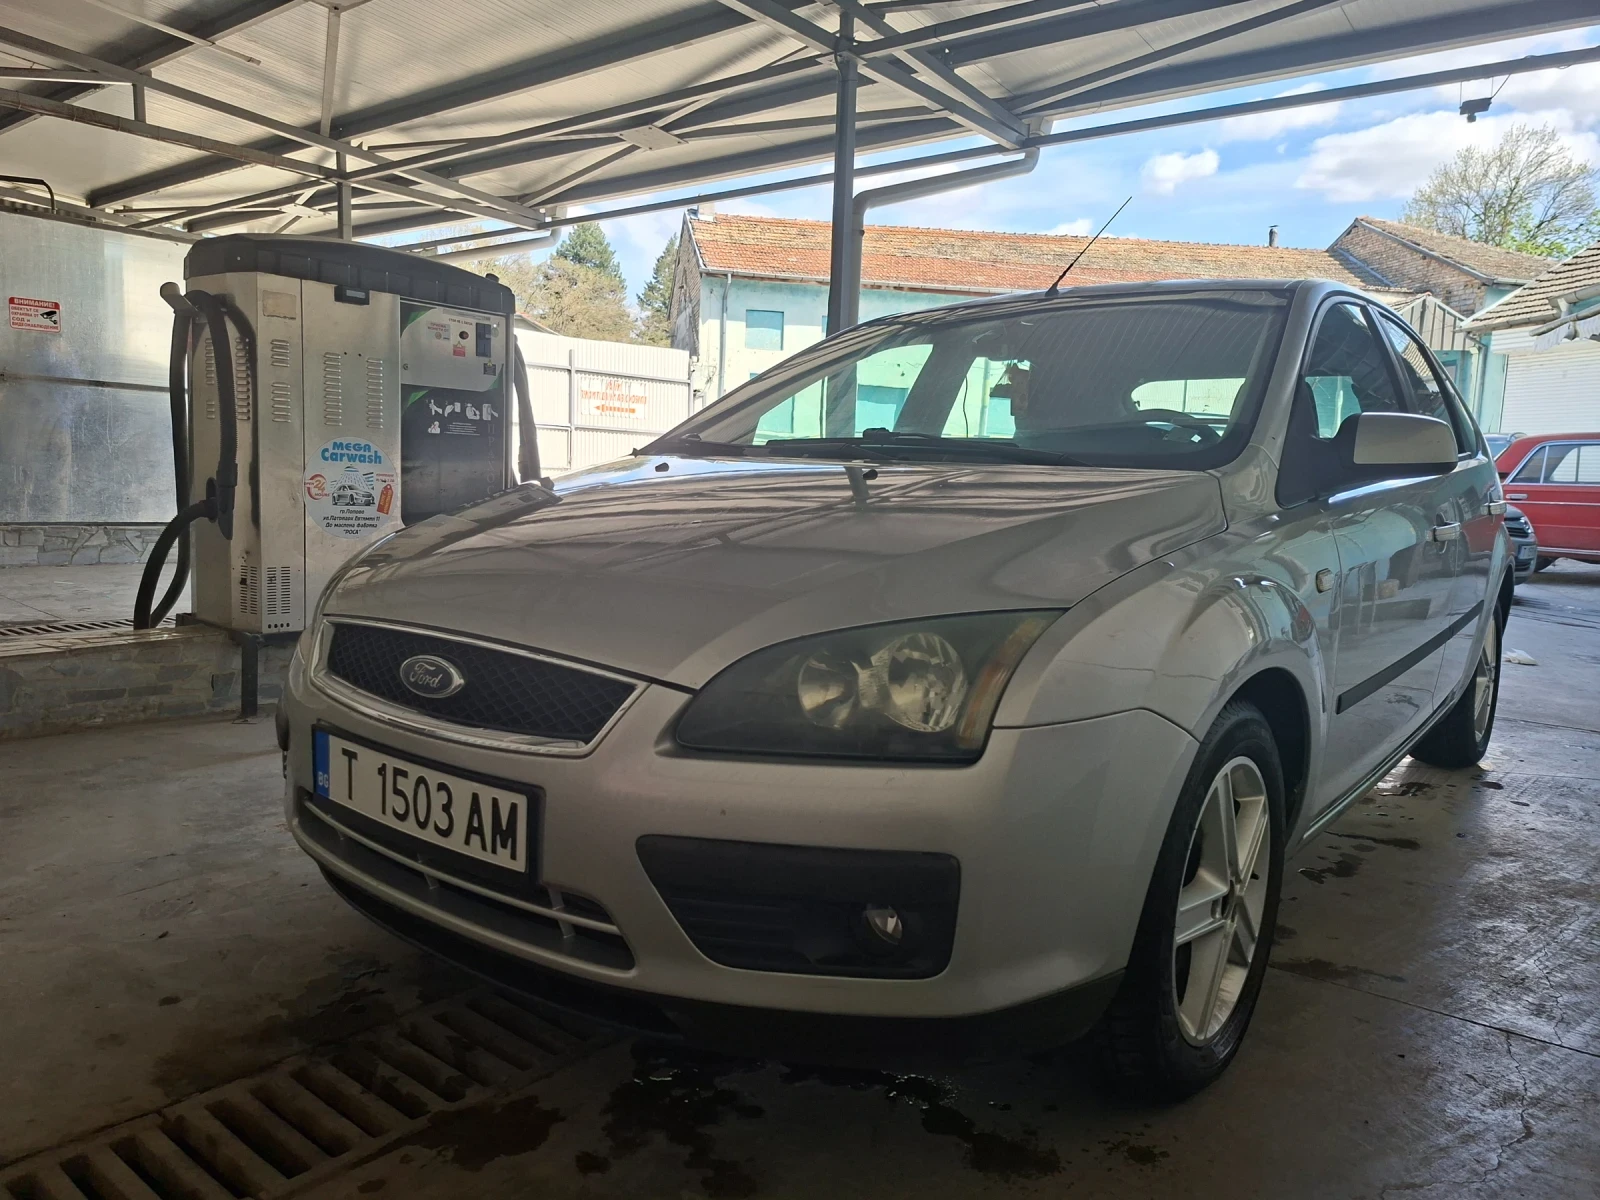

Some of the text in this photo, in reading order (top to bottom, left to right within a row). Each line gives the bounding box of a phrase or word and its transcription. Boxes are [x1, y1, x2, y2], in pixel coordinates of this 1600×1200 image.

[14, 298, 56, 308] ВНИМАНИЕ!
[332, 441, 371, 452] MEGA
[321, 447, 382, 465] Carwash
[313, 479, 326, 493] 24
[409, 662, 443, 689] Ford
[318, 771, 329, 789] BG
[342, 747, 519, 861] T 1503 AM
